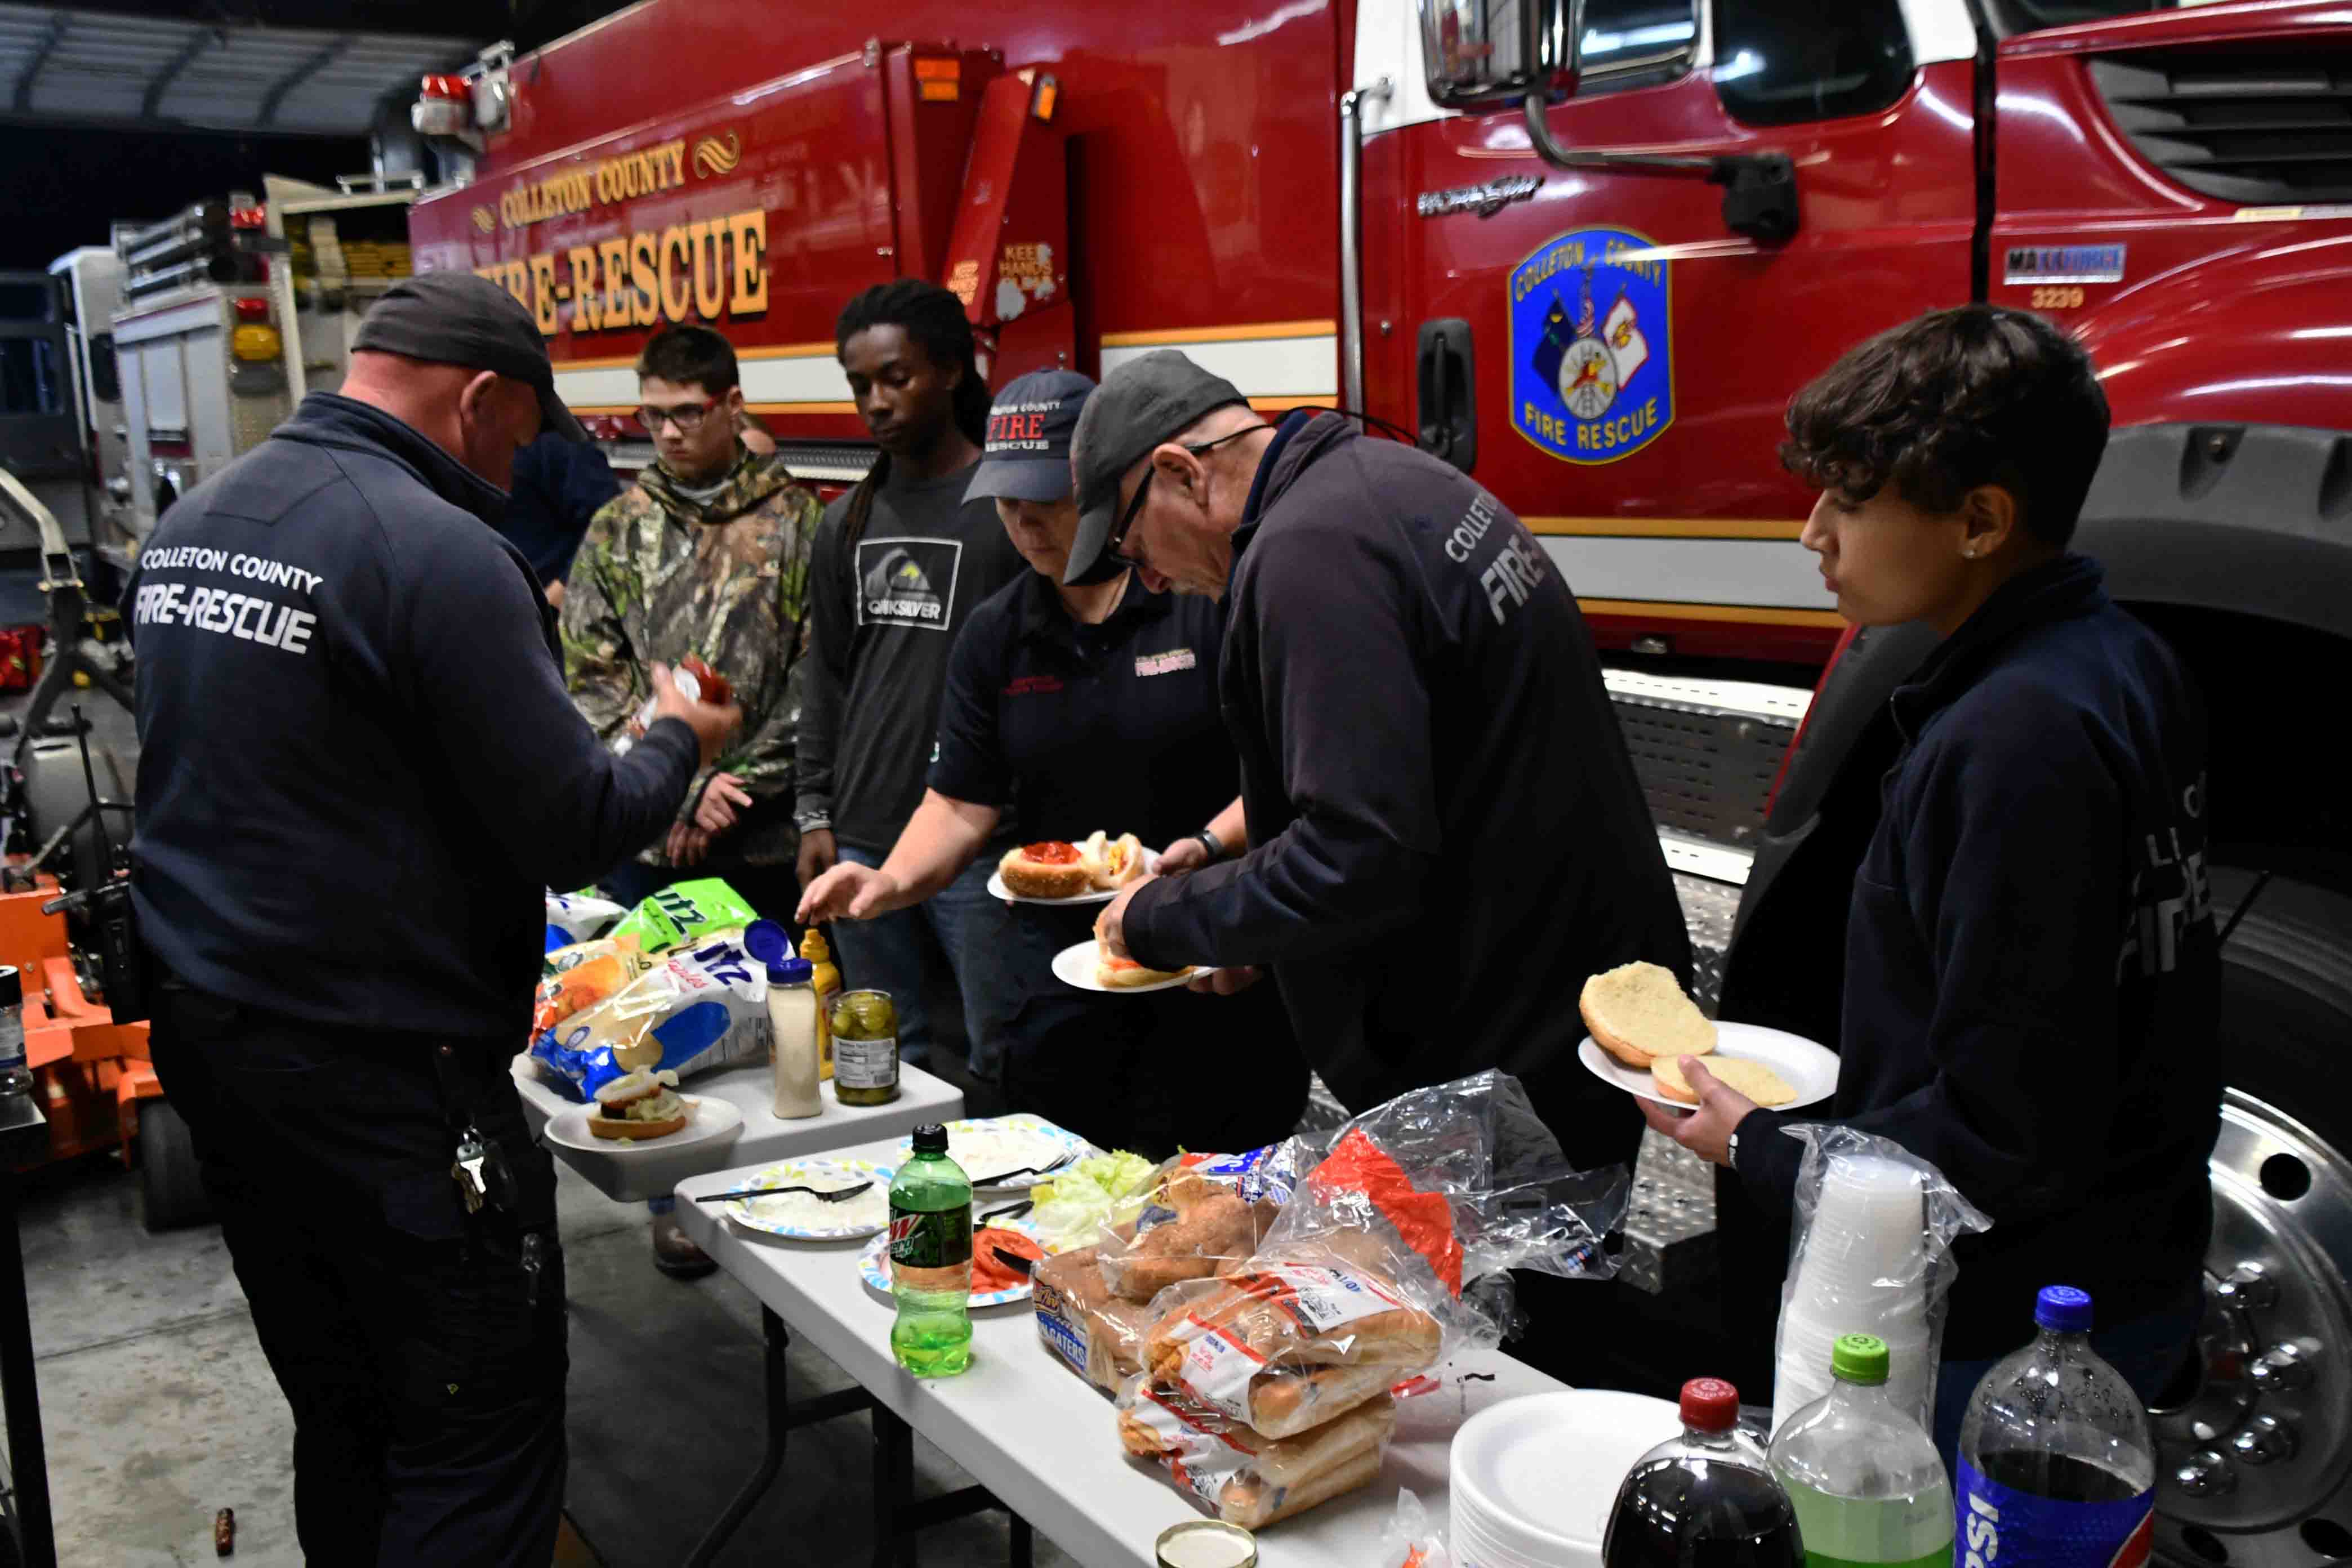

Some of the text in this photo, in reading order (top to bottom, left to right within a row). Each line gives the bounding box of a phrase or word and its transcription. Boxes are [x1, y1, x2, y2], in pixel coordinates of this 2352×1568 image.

[501, 139, 687, 229] COLLETON COUNTY
[1515, 240, 1585, 302] COLLETON
[2032, 286, 2084, 309] 3239
[987, 413, 1046, 443] FIRE
[1524, 397, 1659, 450] FIRE RESCUE
[141, 546, 323, 595] COLLETON COUNTY
[135, 583, 317, 655] FIRE-RESCUE
